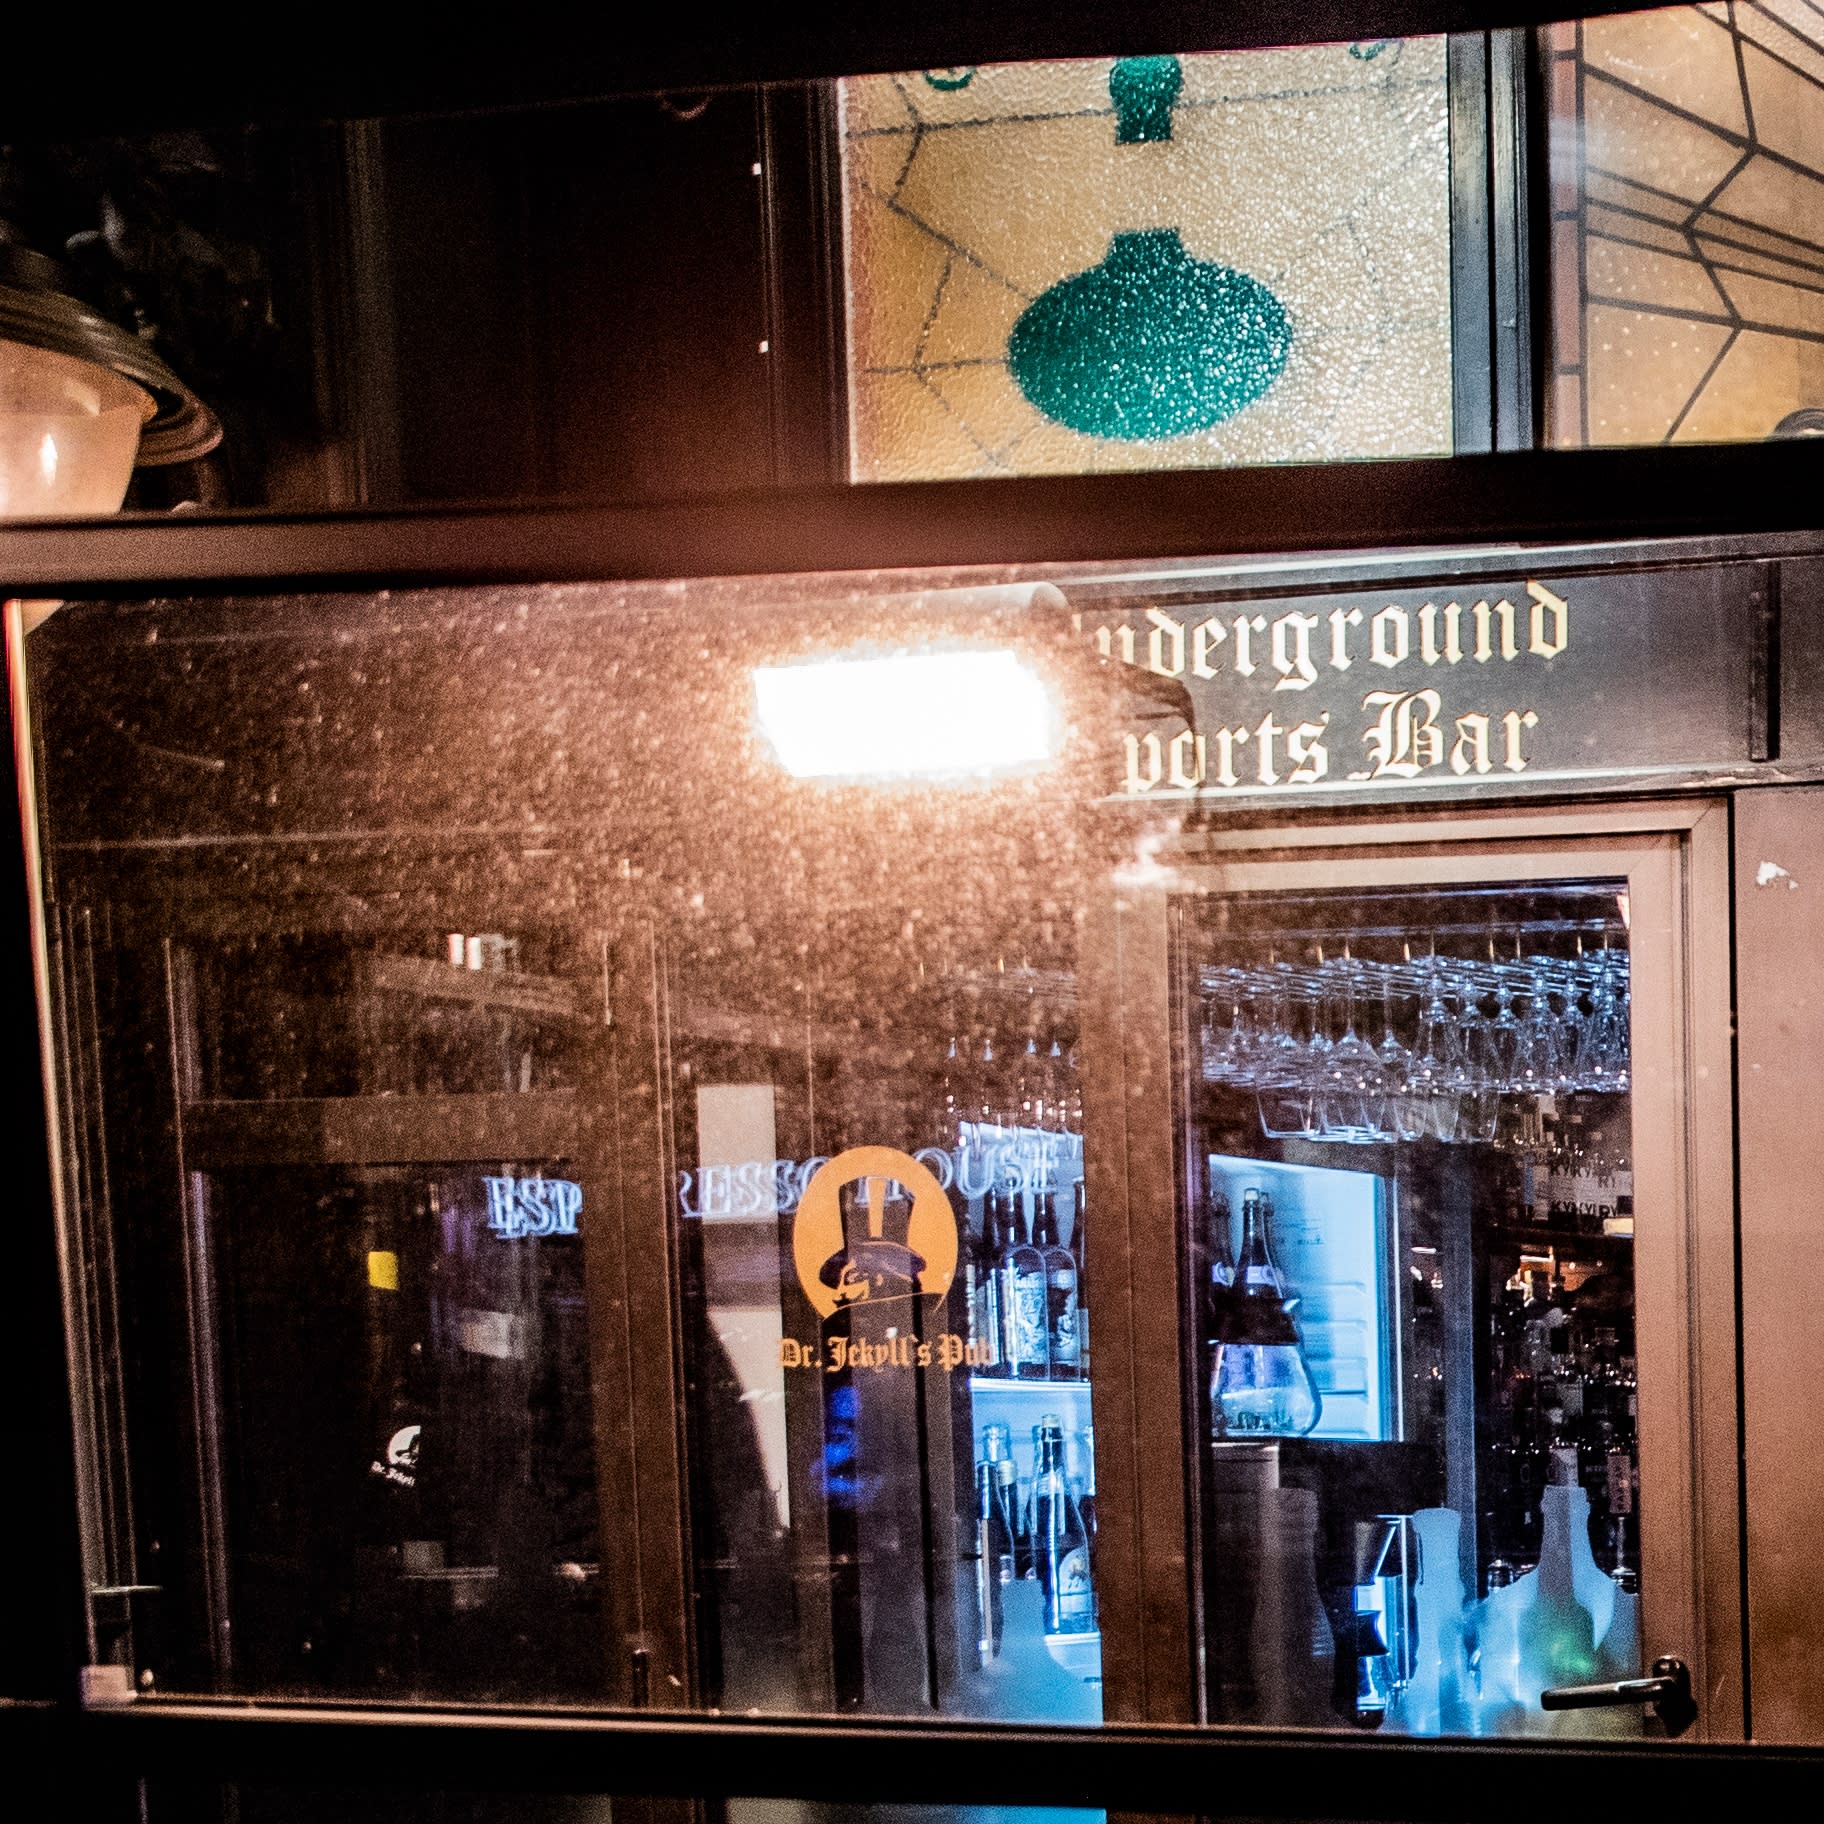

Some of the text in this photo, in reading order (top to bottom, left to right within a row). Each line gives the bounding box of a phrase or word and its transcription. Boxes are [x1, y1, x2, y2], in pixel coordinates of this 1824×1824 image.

[1072, 579, 1569, 691] nderground
[1121, 687, 1541, 793] ports Bar
[778, 1337, 822, 1369] Dr.
